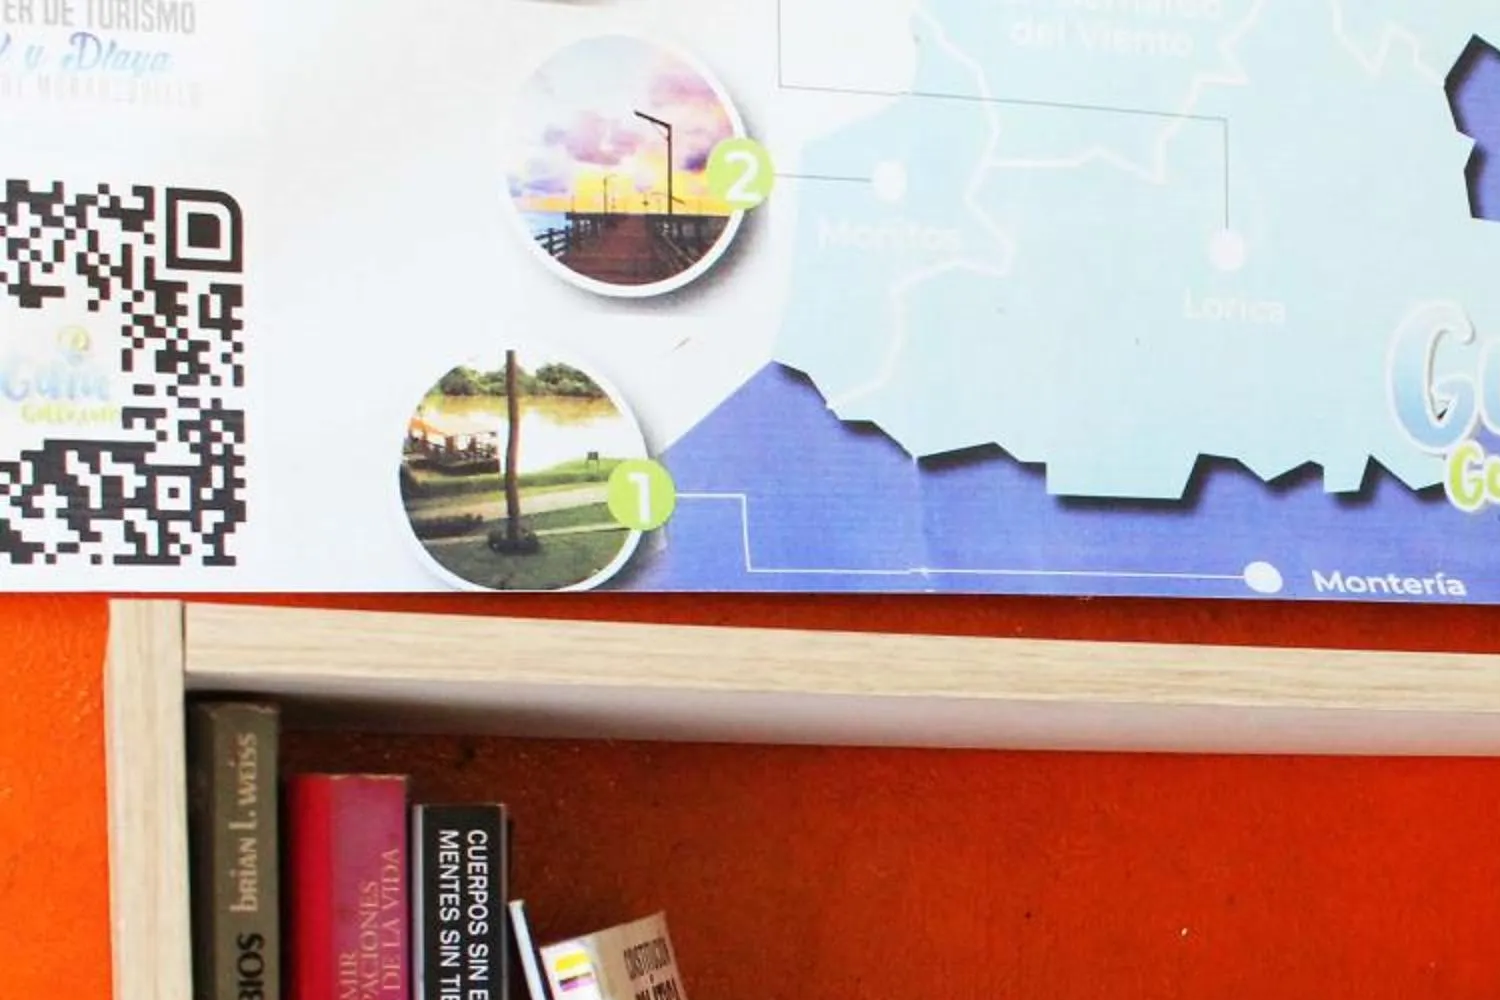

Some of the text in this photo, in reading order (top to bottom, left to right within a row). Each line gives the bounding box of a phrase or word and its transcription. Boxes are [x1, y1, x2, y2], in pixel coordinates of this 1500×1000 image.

[86, 0, 197, 35] TURISMO
[722, 151, 762, 202] 2
[1182, 286, 1285, 326] Lorica
[626, 472, 652, 523] 1
[1312, 569, 1467, 598] Montería
[381, 848, 400, 911] VIDA
[438, 829, 460, 922] MENTES
[466, 829, 489, 937] CUERPOS
[382, 916, 401, 948] LA
[439, 930, 461, 967] SIN
[382, 954, 401, 990] DE
[467, 943, 489, 982] SIN
